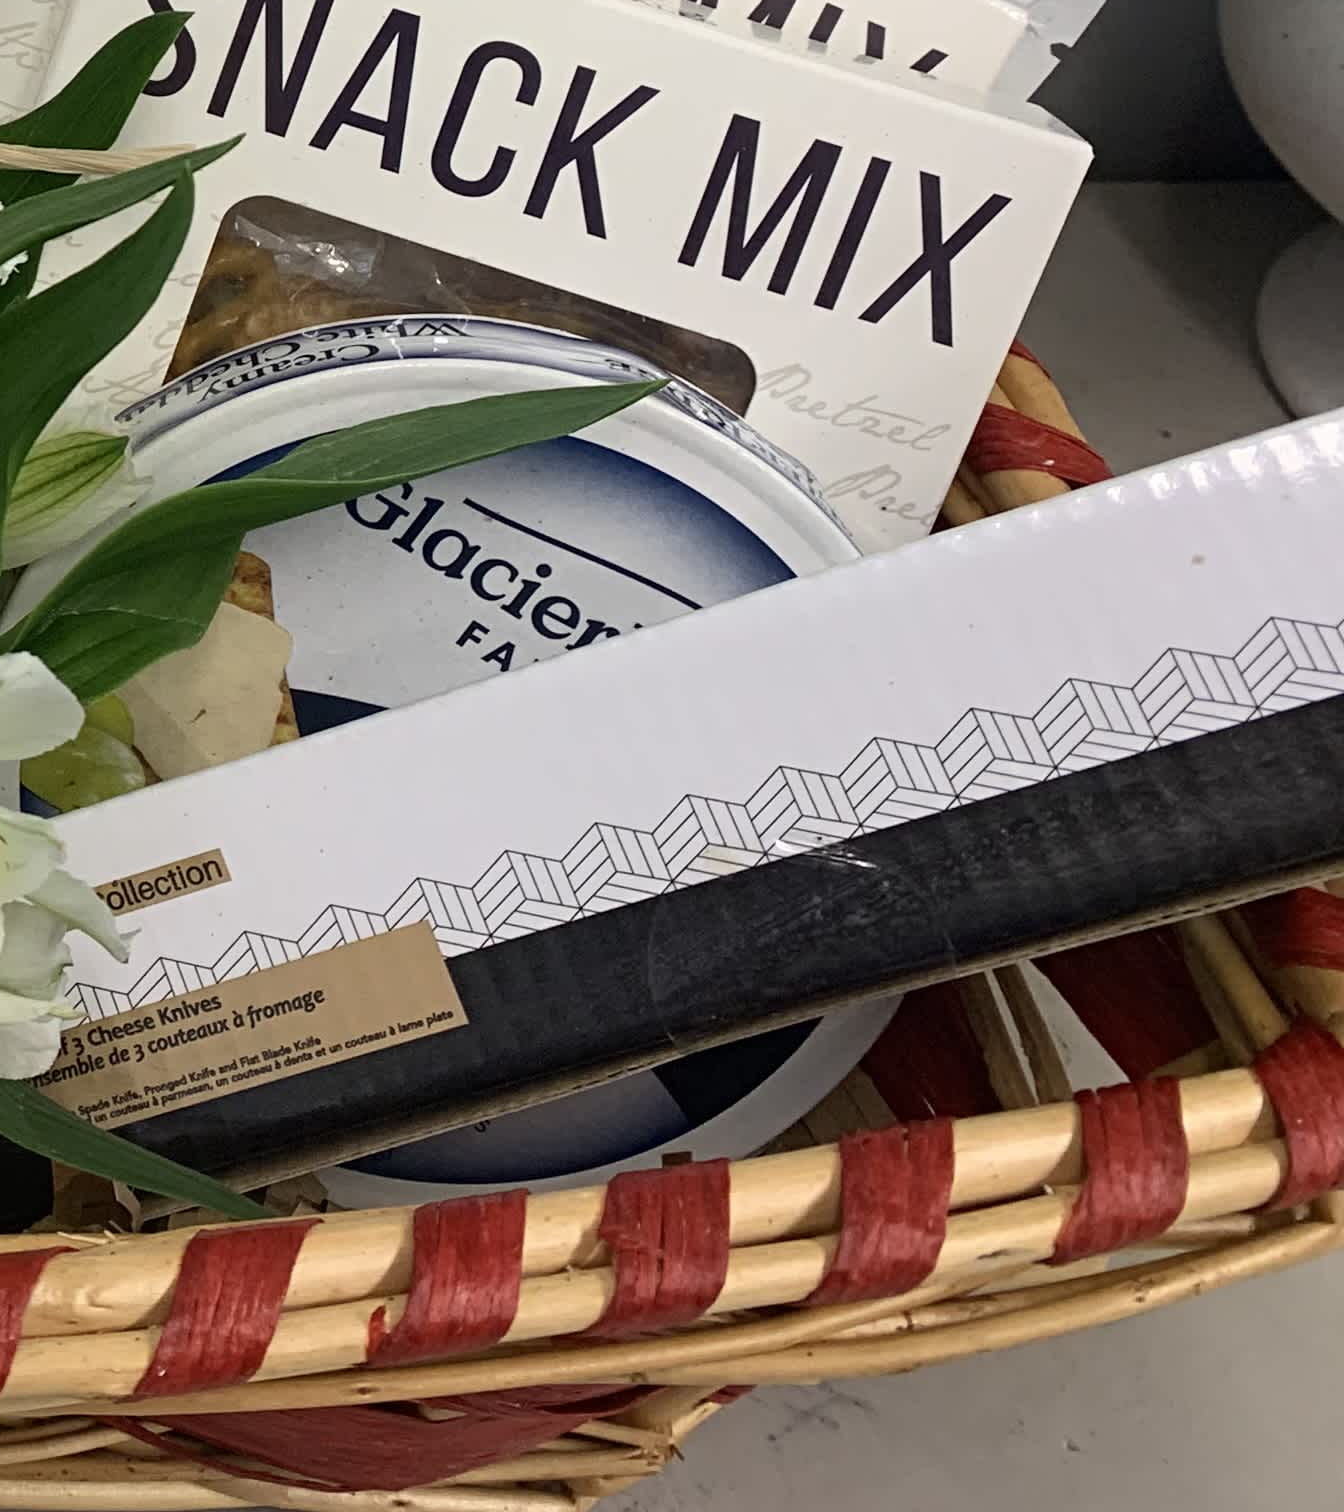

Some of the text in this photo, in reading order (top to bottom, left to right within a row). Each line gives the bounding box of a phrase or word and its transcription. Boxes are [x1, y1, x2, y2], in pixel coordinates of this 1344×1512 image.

[678, 112, 1014, 348] MIX
[198, 343, 380, 404] Creamy
[97, 859, 224, 911] ollection
[30, 988, 326, 1089] nsemble de 3 couteaux à fromage
[72, 1038, 85, 1057] 3
[86, 1014, 156, 1047] Cheese
[157, 994, 222, 1026] Knives
[109, 1100, 151, 1120] couteau
[215, 1076, 230, 1088] un
[231, 1063, 273, 1082] couteau
[283, 1051, 313, 1068] dents
[314, 1047, 327, 1058] et
[328, 1042, 343, 1054] un
[344, 1029, 387, 1049] couteau
[397, 1018, 425, 1033] lame
[425, 1008, 455, 1029] plate
[77, 1099, 111, 1117] Spade
[144, 1075, 188, 1097] Pronged
[188, 1066, 217, 1083] Knife
[218, 1060, 239, 1075] and
[239, 1052, 261, 1068] Flat
[262, 1044, 292, 1061] Blade
[293, 1036, 322, 1052] Knife
